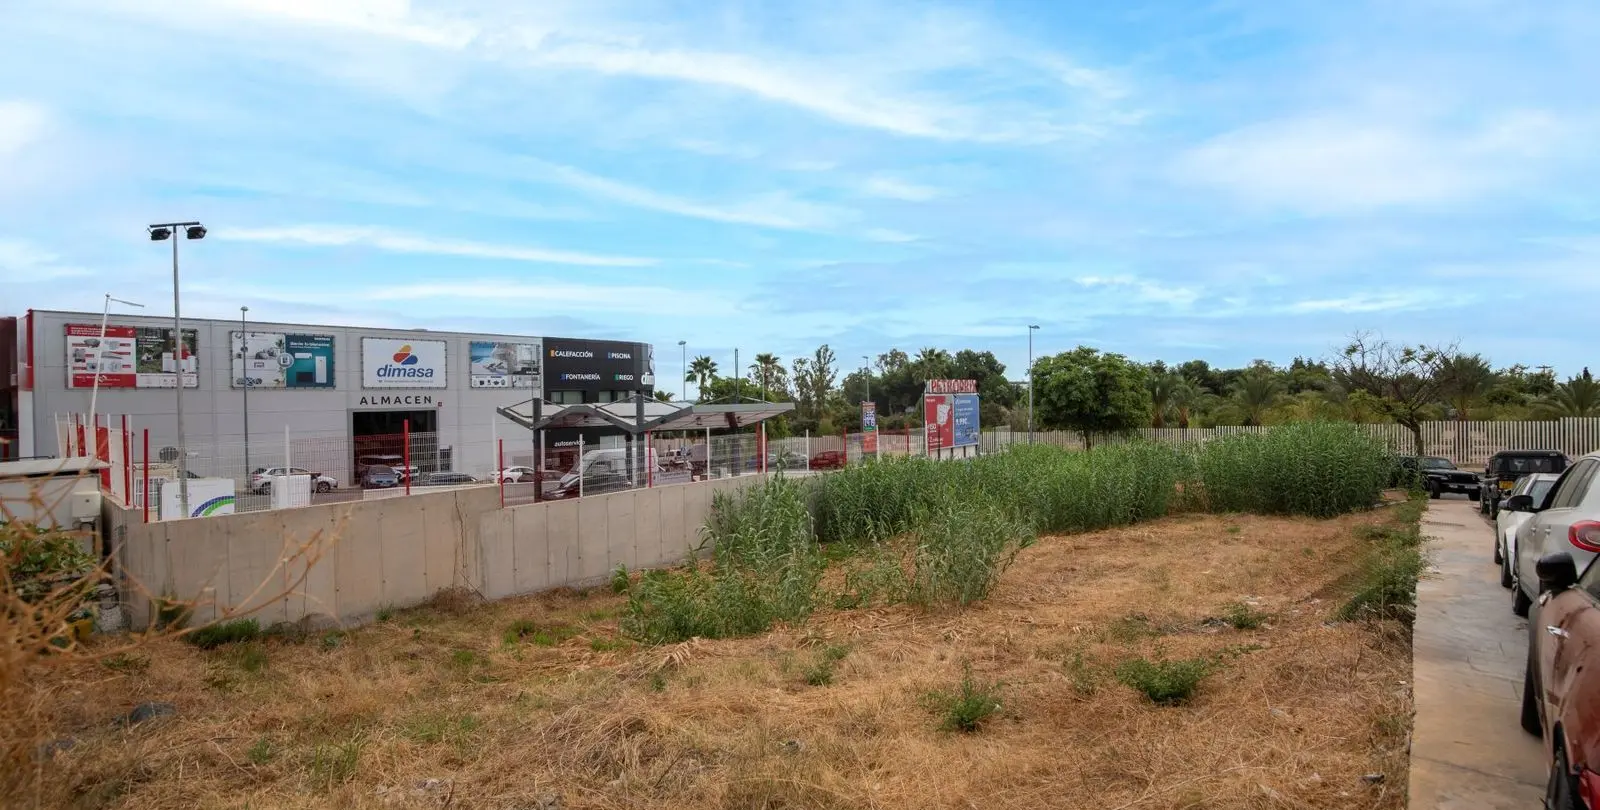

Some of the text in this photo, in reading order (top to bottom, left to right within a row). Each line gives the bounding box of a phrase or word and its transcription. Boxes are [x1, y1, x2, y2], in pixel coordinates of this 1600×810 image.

[555, 350, 593, 358] CALEFACCIÓN
[377, 364, 434, 378] dimasa
[565, 373, 601, 381] FONTANERÍA
[359, 396, 432, 405] ALMACEN
